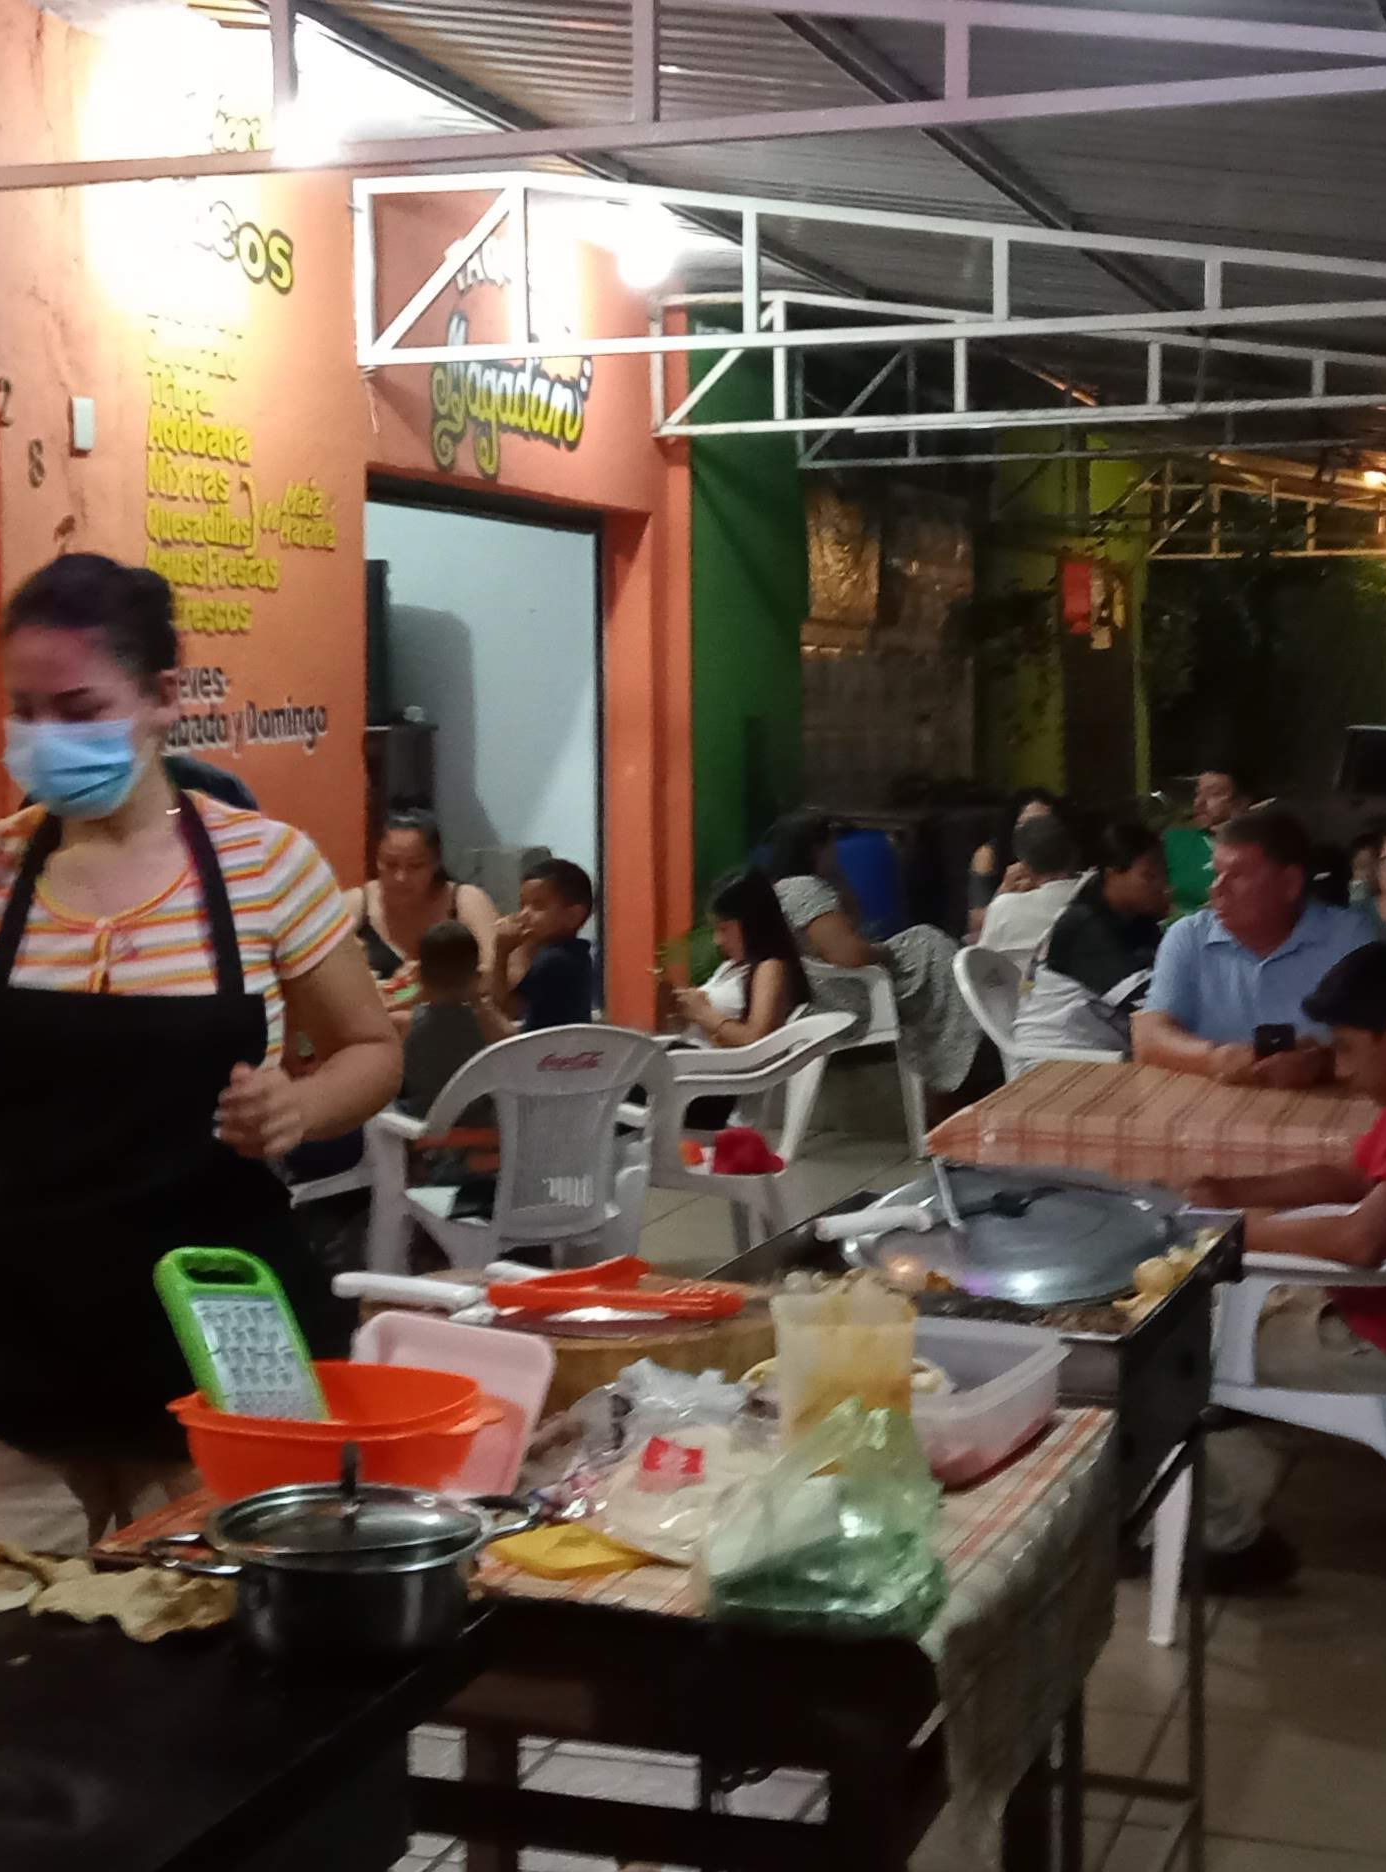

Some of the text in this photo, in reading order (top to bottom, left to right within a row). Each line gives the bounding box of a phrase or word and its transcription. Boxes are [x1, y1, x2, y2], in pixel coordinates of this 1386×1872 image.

[146, 450, 231, 504] Mixtas
[145, 500, 253, 549] Quesadillas
[229, 711, 246, 759] y
[245, 696, 328, 755] Domingo
